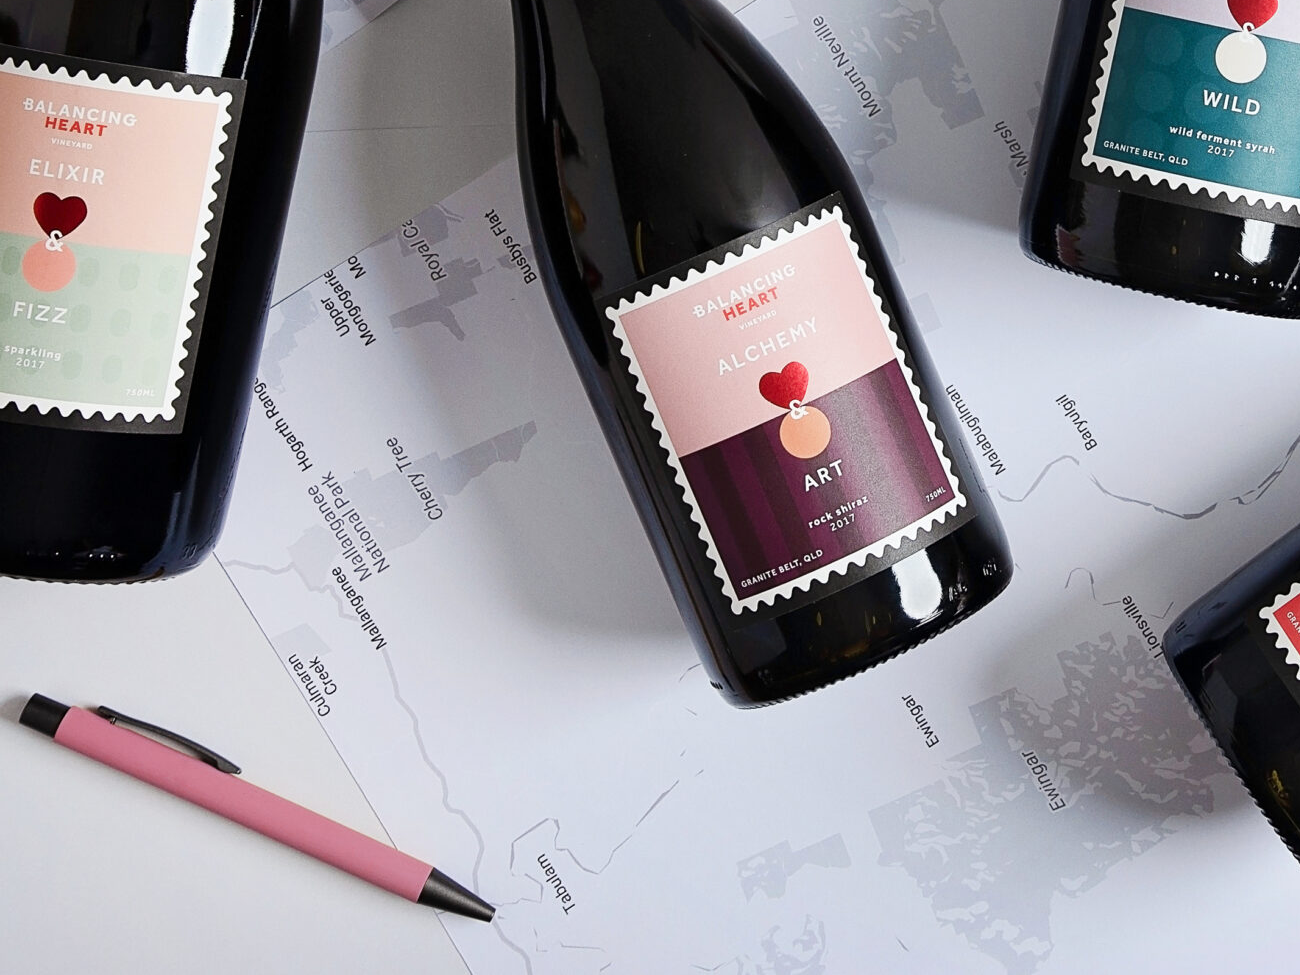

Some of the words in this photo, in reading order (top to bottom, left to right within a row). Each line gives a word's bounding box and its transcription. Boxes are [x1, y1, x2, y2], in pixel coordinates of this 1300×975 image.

[812, 15, 850, 69] Neville
[844, 65, 882, 117] Mount
[1202, 89, 1262, 117] WILD
[22, 97, 138, 127] BALANCING
[44, 116, 108, 137] HEART
[50, 137, 94, 151] VINEYARD
[992, 121, 1030, 168] Marsh
[1102, 139, 1141, 156] GRANITE
[1142, 149, 1166, 163] BELT,
[1168, 155, 1189, 167] QLD
[1168, 125, 1194, 139] wild
[1196, 130, 1242, 149] ferment
[1244, 140, 1276, 155] syrah
[1206, 145, 1235, 158] 2017
[28, 157, 106, 185] ELIXIR
[484, 207, 506, 238] Flat
[410, 239, 447, 281] Royal
[502, 234, 538, 285] Busbys
[692, 263, 796, 319] BALANCING
[722, 287, 780, 322] HEART
[12, 301, 68, 325] FIZZ
[320, 297, 350, 338] Upper
[737, 309, 778, 331] VINEYARD
[4, 343, 62, 362] sparkling
[14, 357, 46, 371] 2017
[716, 316, 820, 377] ALCHEMY
[124, 387, 156, 398] 750ML
[254, 377, 280, 419] Rang
[944, 383, 1006, 476] Malabugilman
[1055, 393, 1098, 451] Baryulgil
[274, 417, 313, 473] Hogarth
[386, 437, 412, 473] Tree
[320, 470, 350, 509] Park
[802, 459, 844, 493] ART
[925, 485, 947, 503] 750ML
[408, 473, 444, 521] Cherry
[808, 509, 834, 529] rock
[834, 495, 869, 517] shiraz
[308, 484, 372, 583] Mallanganee
[342, 508, 390, 573] National
[828, 513, 856, 533] 2017
[740, 567, 778, 589] GRANITE
[778, 559, 804, 576] BELT,
[802, 549, 824, 563] QLD
[332, 565, 388, 651] Mallanganee
[1121, 595, 1166, 659] Lionsville
[288, 653, 331, 717] Culmaran
[308, 655, 338, 696] Creek
[900, 693, 940, 749] Ewingar
[1021, 749, 1066, 812] Ewingar
[536, 853, 576, 915] Tabulam
